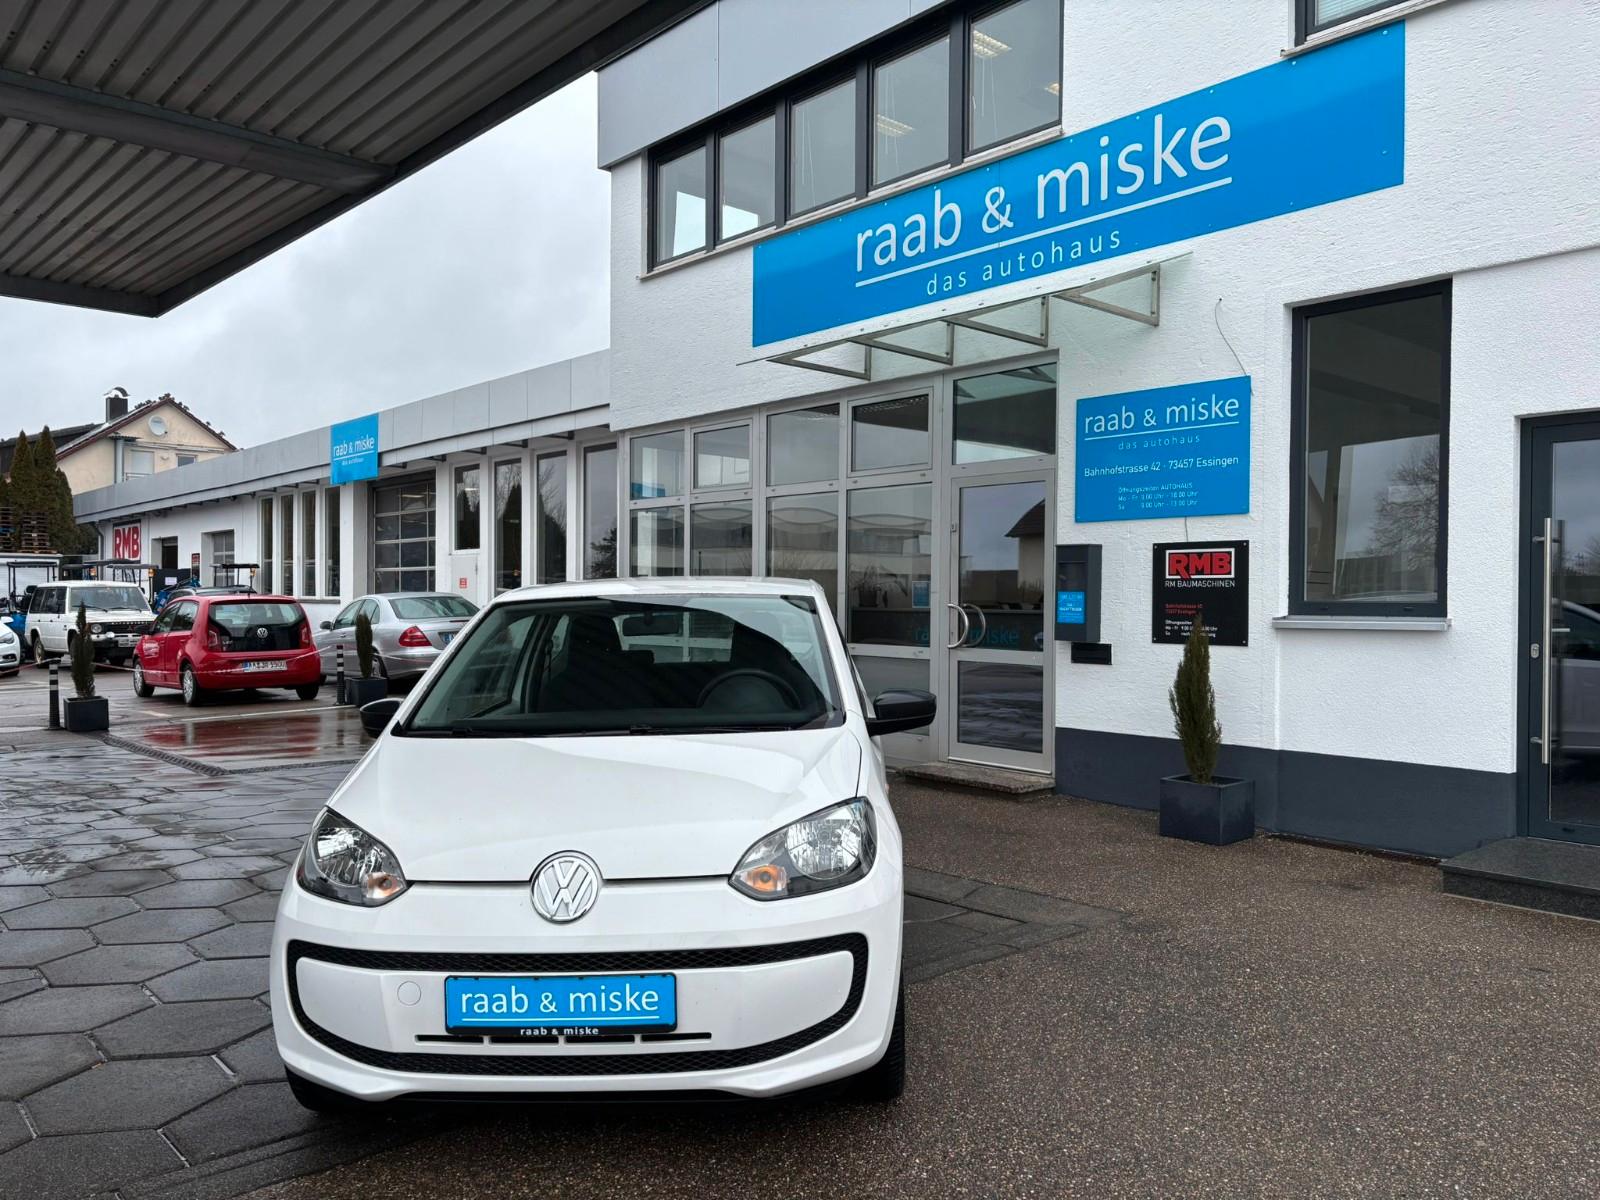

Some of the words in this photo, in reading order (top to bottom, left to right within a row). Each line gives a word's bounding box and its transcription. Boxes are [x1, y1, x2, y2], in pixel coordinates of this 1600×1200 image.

[856, 187, 962, 271] raab
[981, 187, 1014, 234] &
[1037, 114, 1231, 219] miske
[926, 271, 967, 295] das
[982, 231, 1120, 281] autohaus
[1085, 405, 1135, 433] raab
[1143, 409, 1157, 427] &
[1166, 394, 1239, 424] miske
[333, 441, 348, 457] raab
[354, 433, 375, 452] miske
[1118, 439, 1137, 450] das
[1143, 436, 1201, 448] autohaus
[1084, 464, 1149, 477] Bahnhofstrasse
[1150, 461, 1161, 471] 42
[1168, 459, 1194, 470] 73457
[1196, 456, 1239, 469] Essingen
[1161, 481, 1193, 490] AUTOHAUS
[114, 525, 140, 560] RMB
[1169, 552, 1232, 579] RMB
[1165, 580, 1176, 588] RM
[1177, 580, 1236, 588] BAUMASCHINEN
[461, 984, 529, 1014] raab
[539, 992, 558, 1013] &
[569, 983, 659, 1013] miske
[520, 1026, 548, 1036] raab
[563, 1025, 599, 1036] miske
